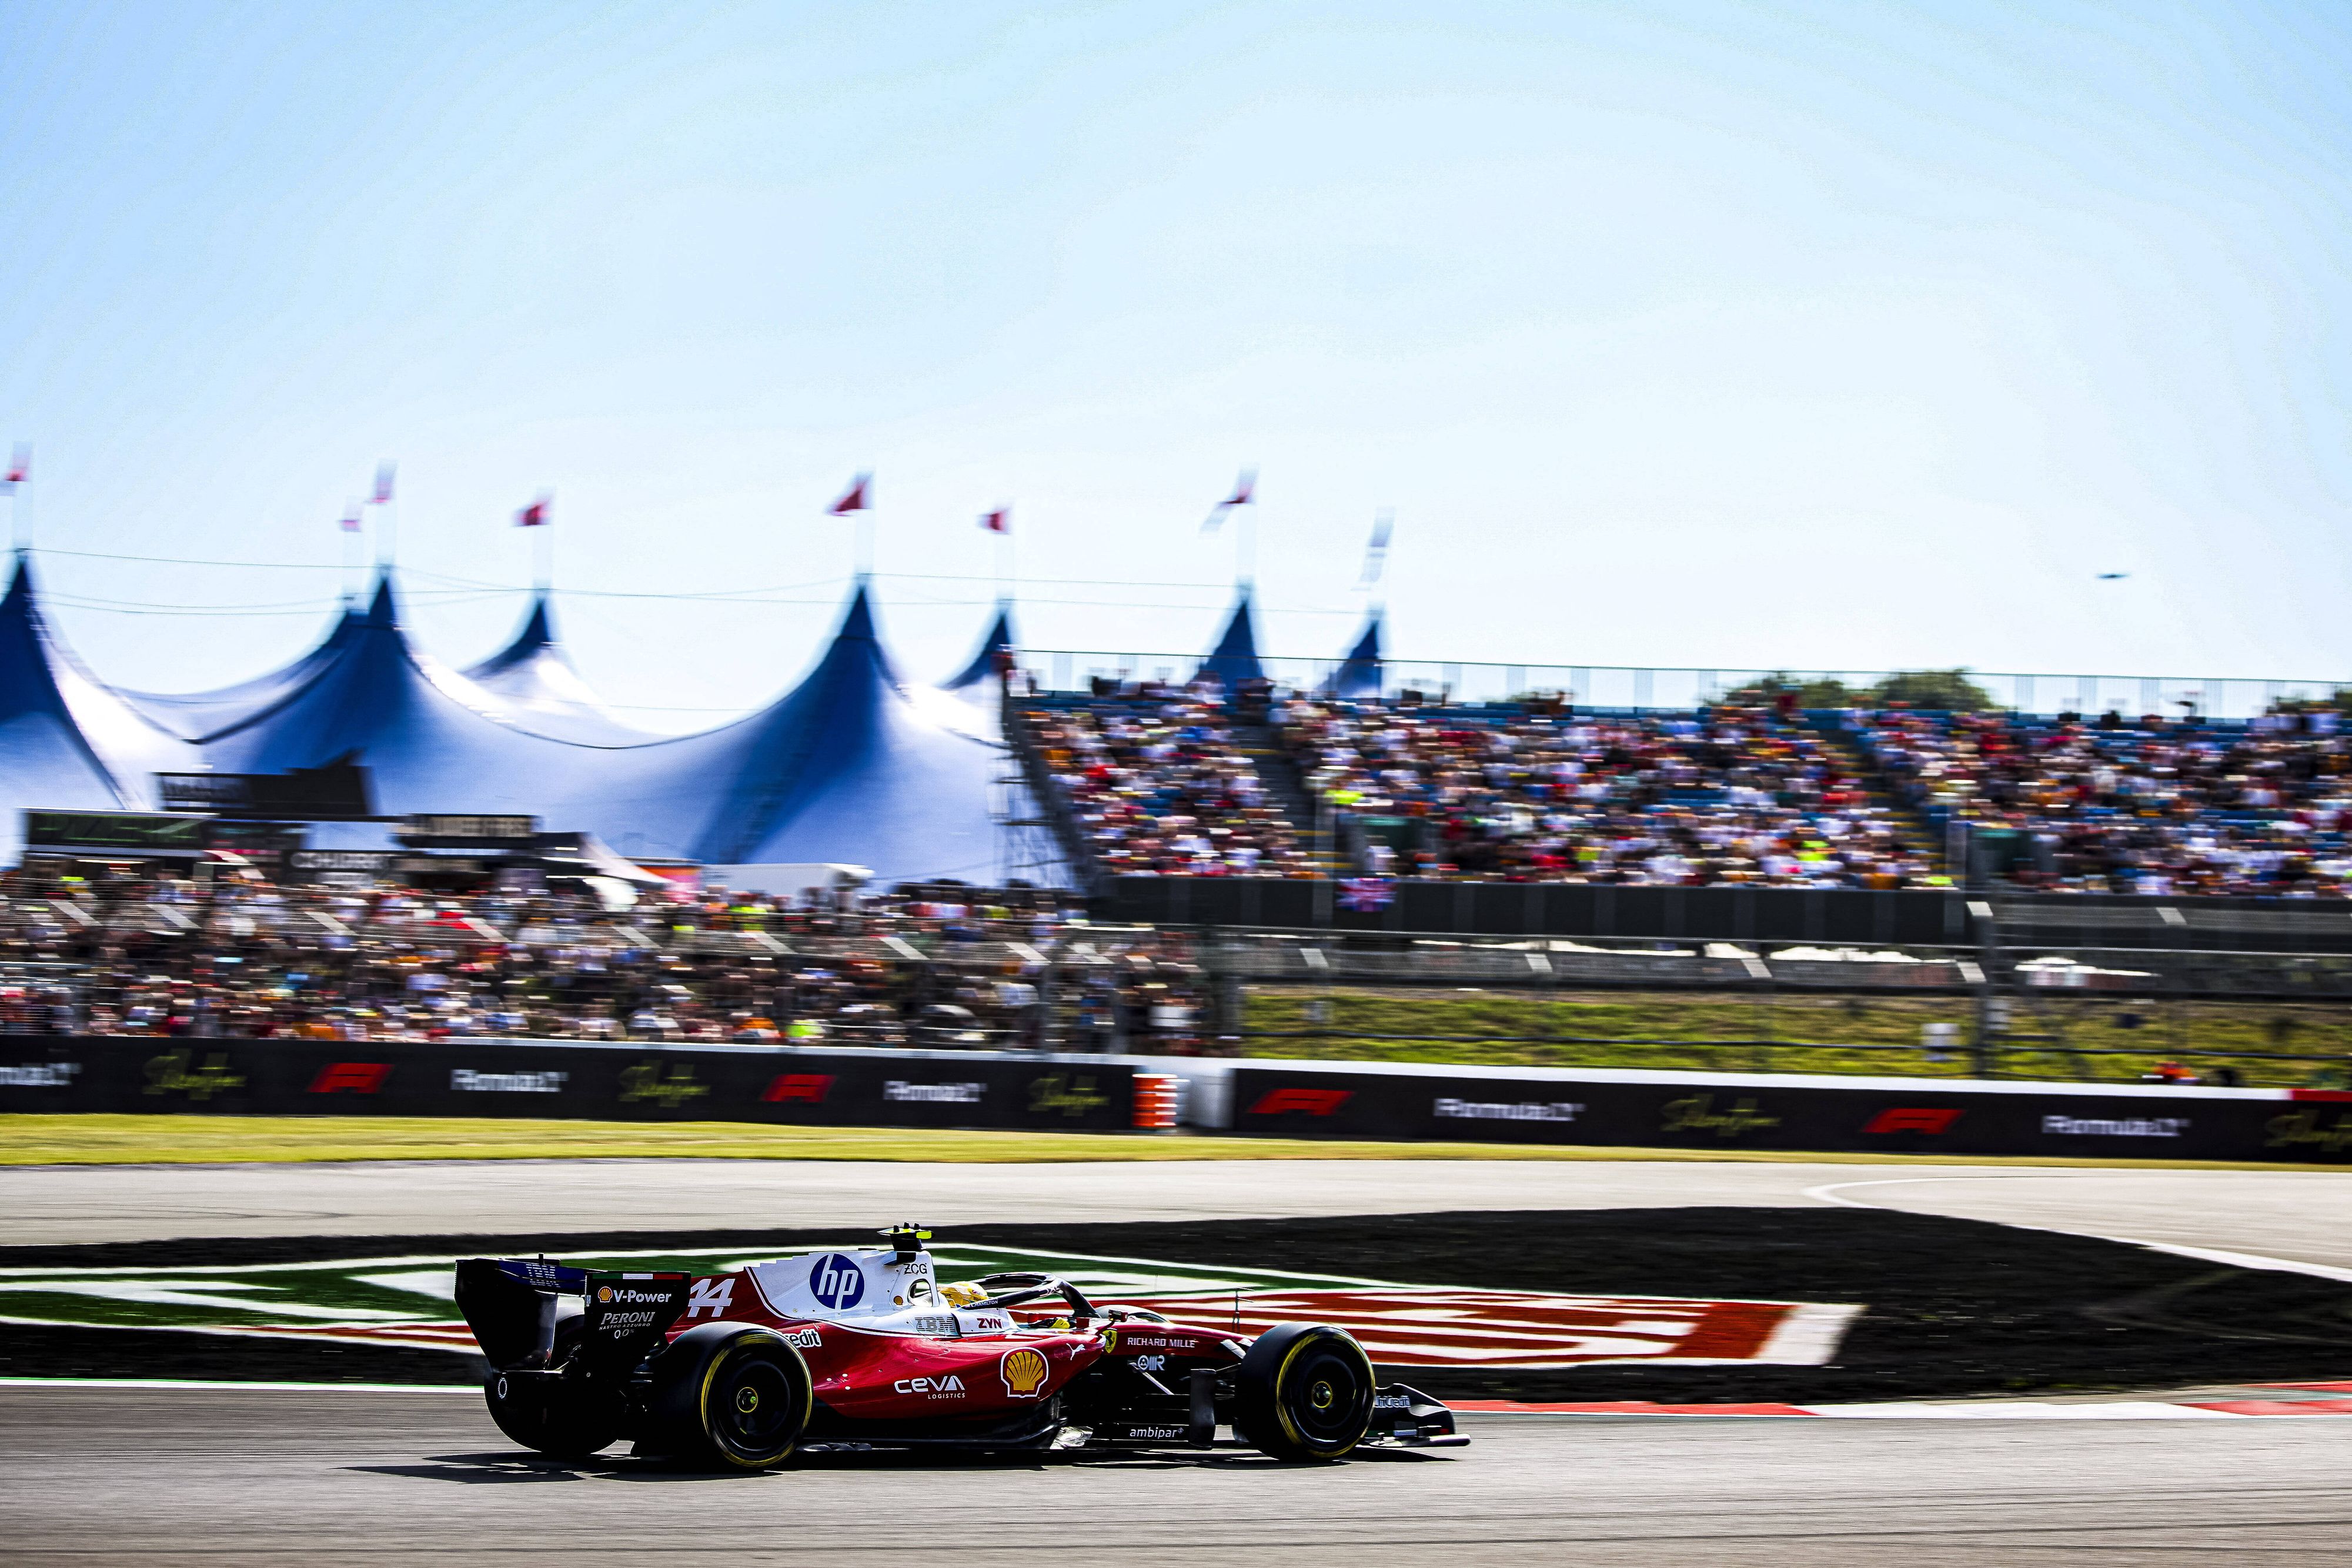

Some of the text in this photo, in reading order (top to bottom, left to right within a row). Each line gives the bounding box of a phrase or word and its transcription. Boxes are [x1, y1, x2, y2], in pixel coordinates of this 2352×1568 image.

[903, 1263, 927, 1275] ZCG
[817, 1253, 858, 1310] hp
[613, 1290, 671, 1302] V-Power
[687, 1279, 736, 1317] 44
[600, 1312, 656, 1325] PERONI
[914, 1316, 957, 1332] IBM
[977, 1318, 1003, 1329] ZYN
[1127, 1338, 1195, 1348] RICHARD MILLE
[1130, 1427, 1177, 1439] ambipar
